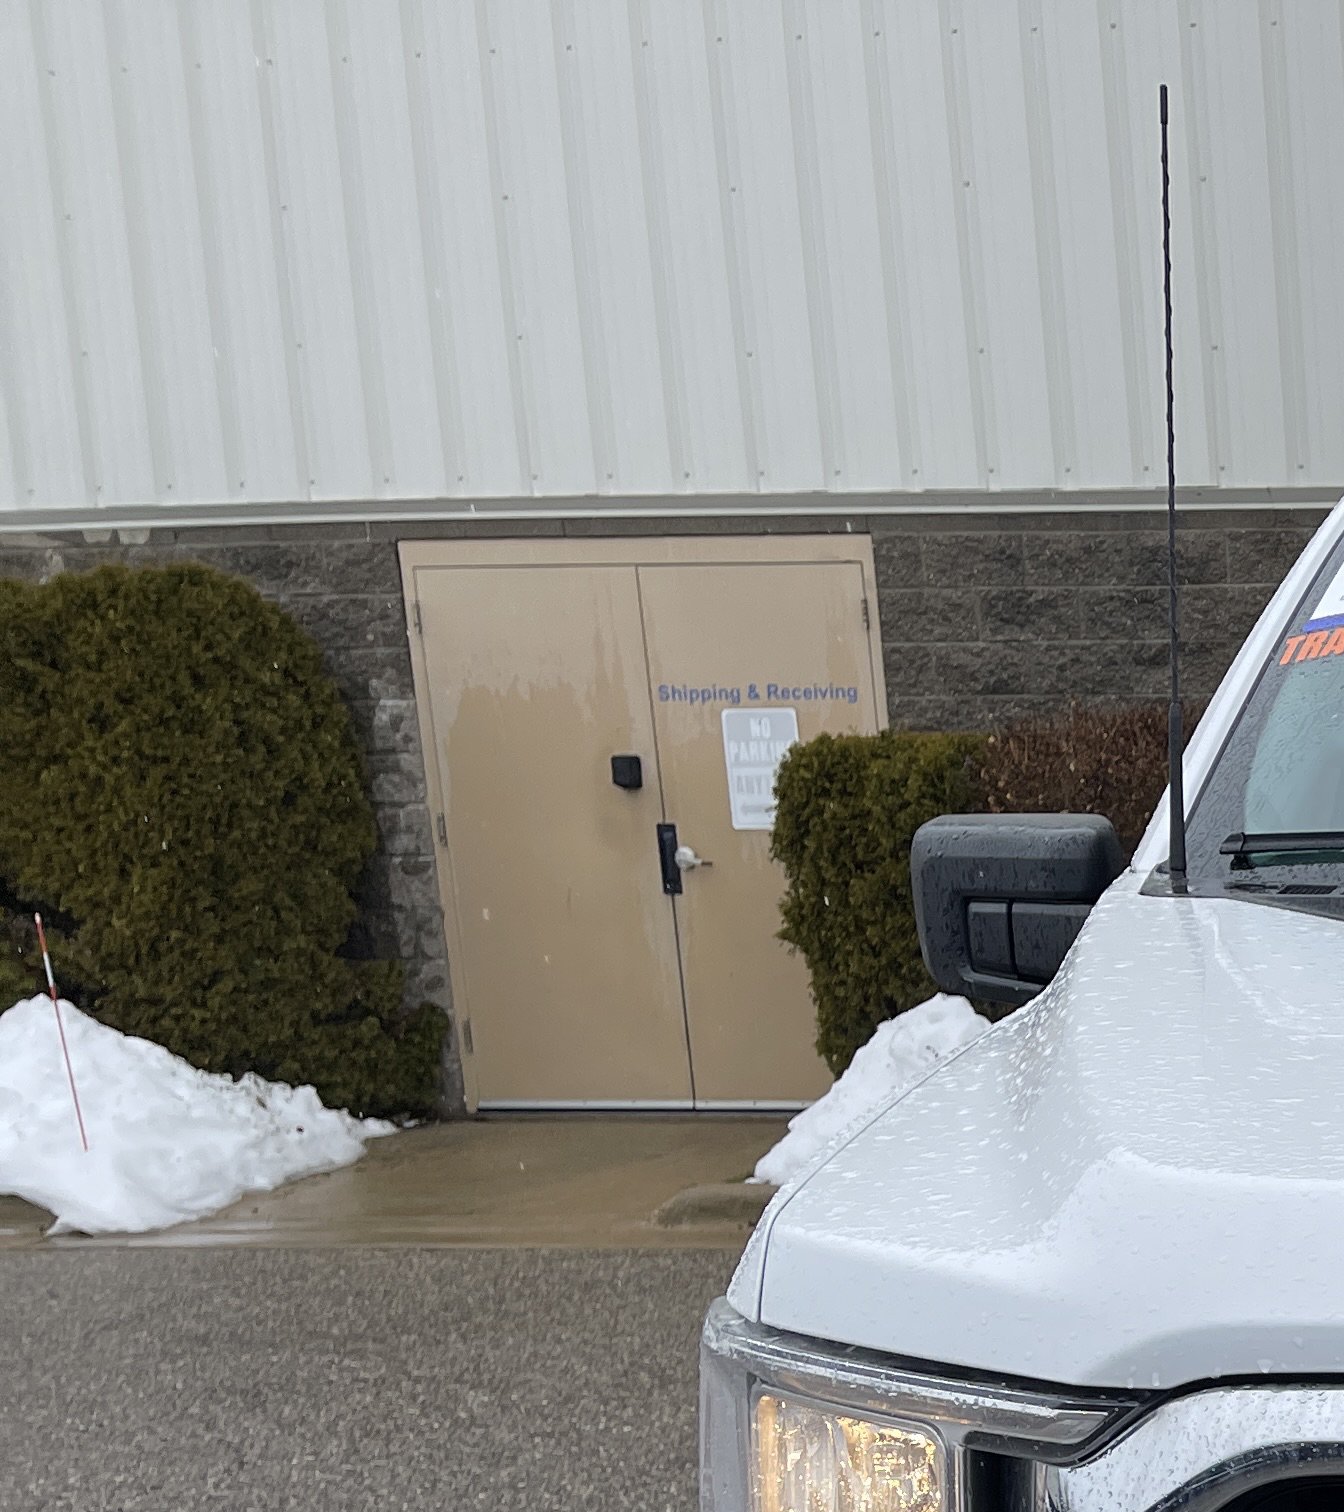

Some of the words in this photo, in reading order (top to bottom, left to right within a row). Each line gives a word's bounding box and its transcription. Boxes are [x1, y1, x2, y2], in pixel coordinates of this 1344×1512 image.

[658, 684, 741, 705] Shipping
[747, 683, 760, 700] &
[767, 683, 858, 704] Receiving
[749, 717, 771, 739] NO
[729, 740, 788, 763] PARKIN
